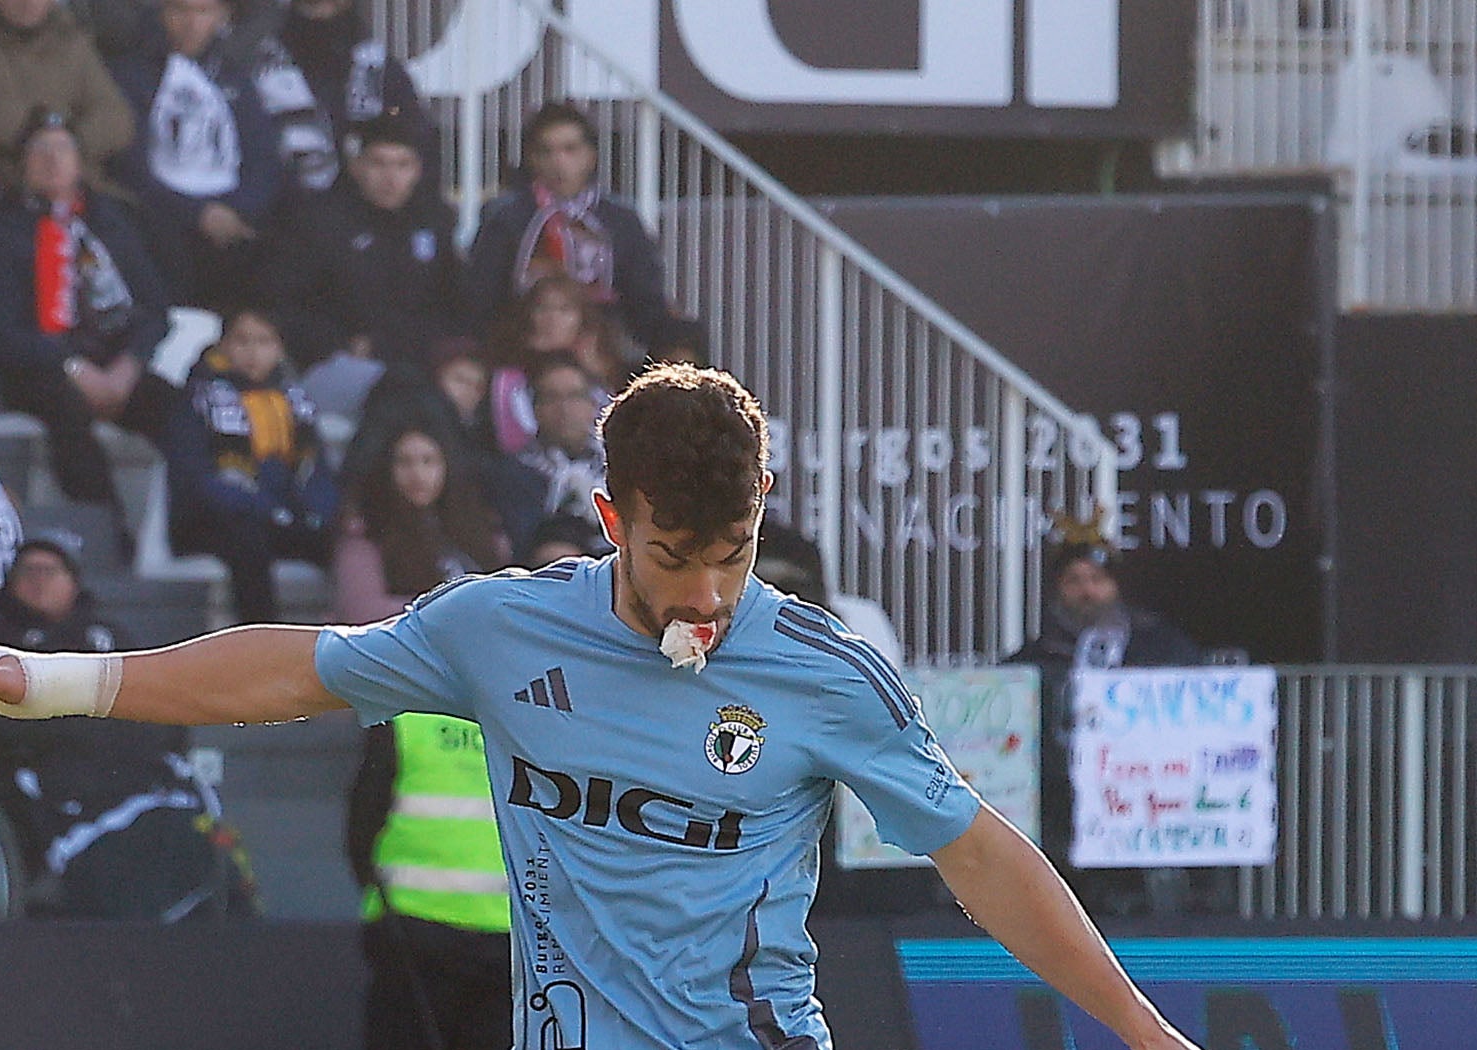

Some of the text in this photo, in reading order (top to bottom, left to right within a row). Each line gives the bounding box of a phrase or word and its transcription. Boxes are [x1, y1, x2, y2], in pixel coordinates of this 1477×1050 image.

[1026, 411, 1189, 471] 2031
[508, 755, 746, 850] DIGI
[525, 857, 538, 903] 2031
